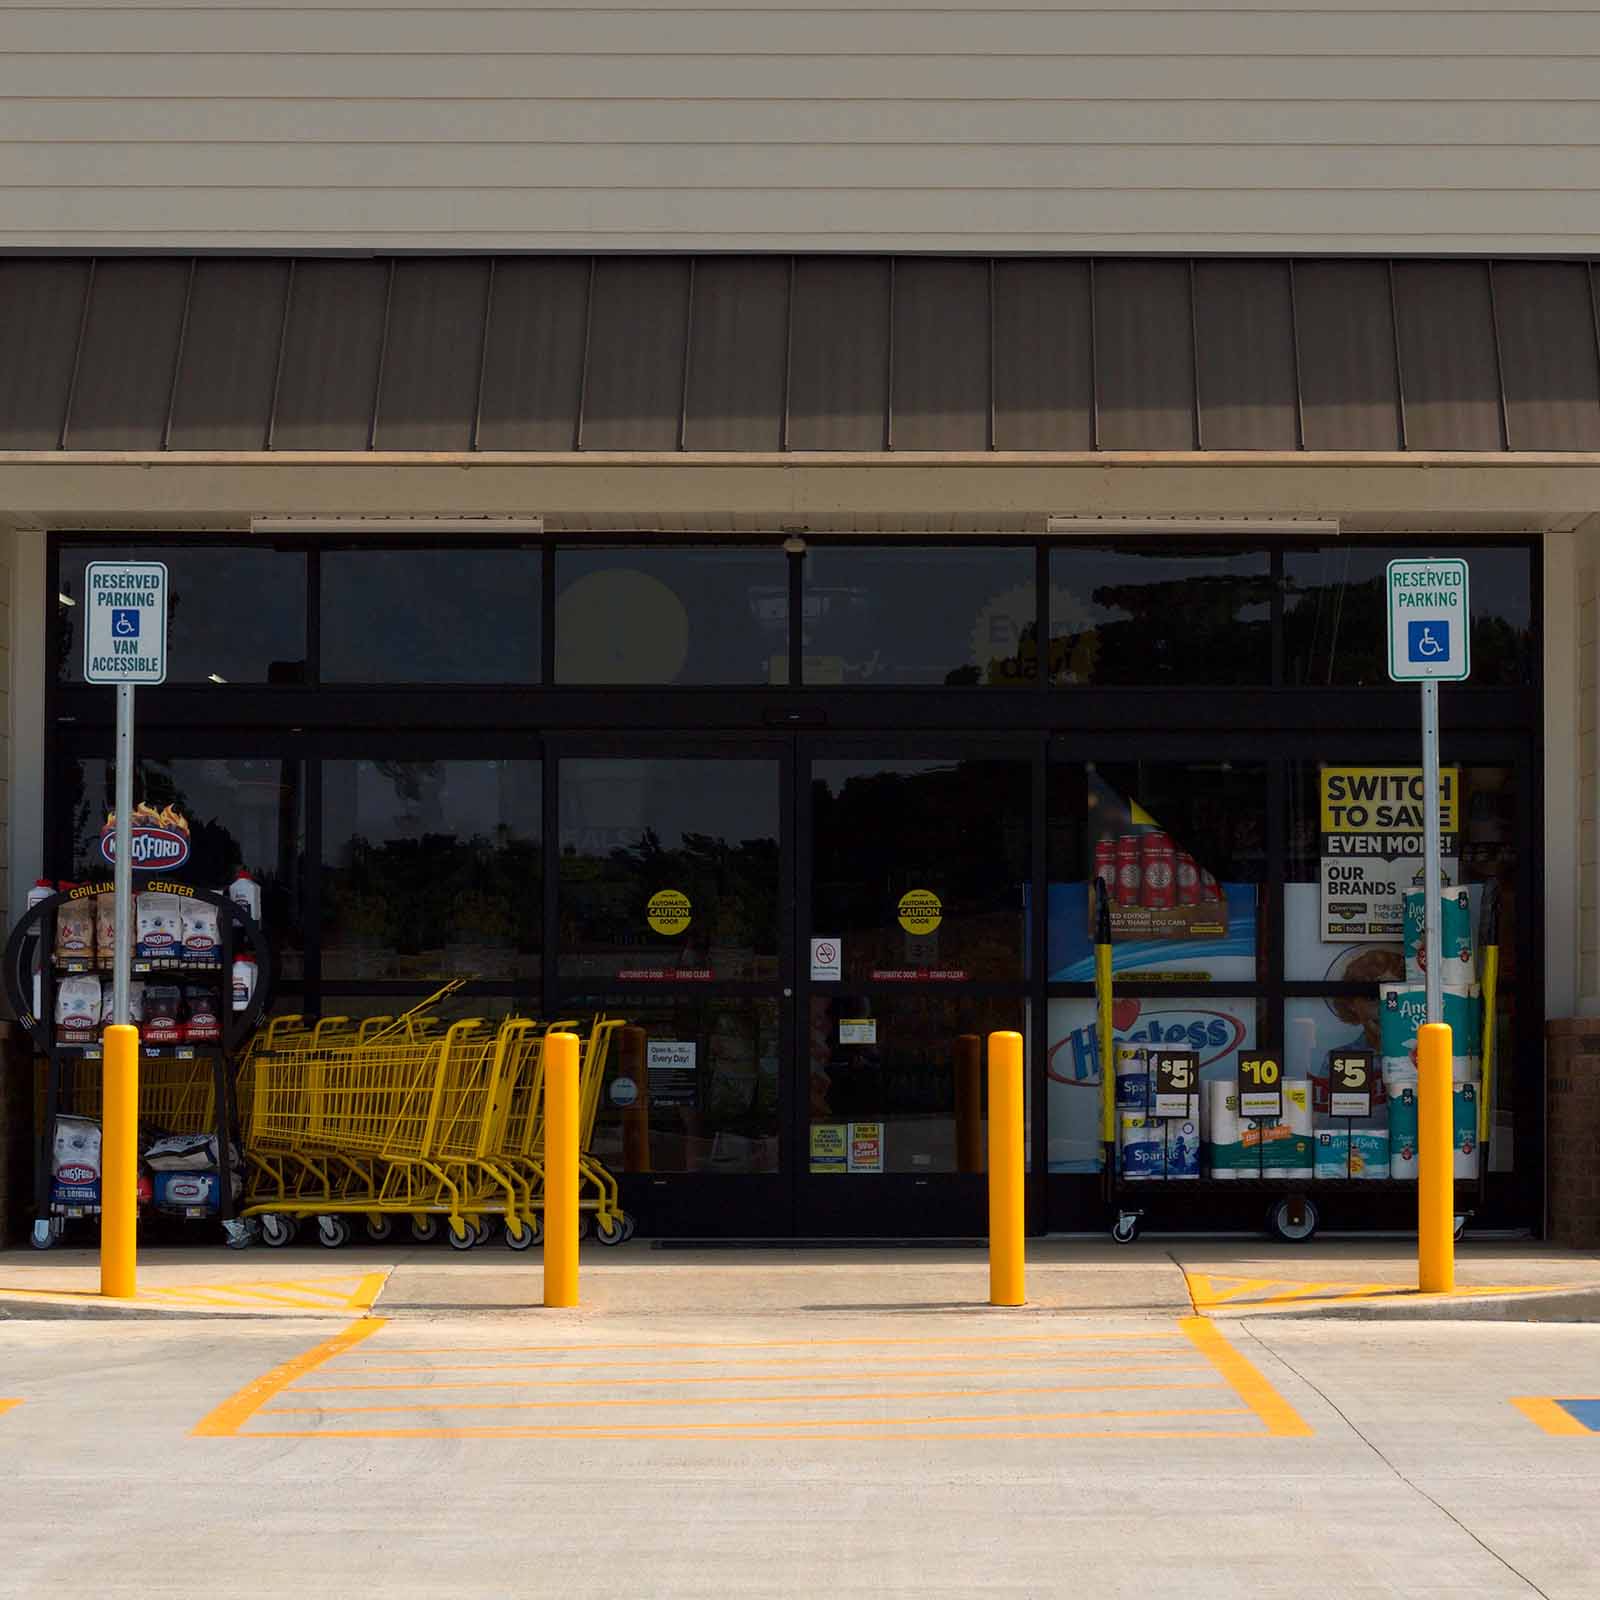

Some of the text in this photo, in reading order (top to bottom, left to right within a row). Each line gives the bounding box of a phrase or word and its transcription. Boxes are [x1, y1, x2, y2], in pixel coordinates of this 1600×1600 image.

[93, 574, 160, 589] RESERVED
[1394, 571, 1462, 587] RESERVED
[98, 592, 155, 607] PARKING
[1399, 592, 1457, 607] PARKING
[113, 639, 138, 655] VAN
[92, 657, 159, 672] ACCESSIBLE
[1327, 775, 1451, 801] SWITCH
[1327, 806, 1369, 828] TO
[109, 834, 181, 861] KGSFORD
[1327, 836, 1382, 853] EVEN
[1327, 866, 1364, 880] OUR
[69, 881, 194, 899] GRILLIN CENTER
[1327, 882, 1397, 896] BRANDS
[650, 908, 689, 917] CAUTION
[900, 908, 940, 917] CAUTION
[652, 1054, 673, 1065] Every
[1161, 1059, 1195, 1089] $5
[1240, 1059, 1279, 1086] $10
[1333, 1058, 1367, 1088] $5
